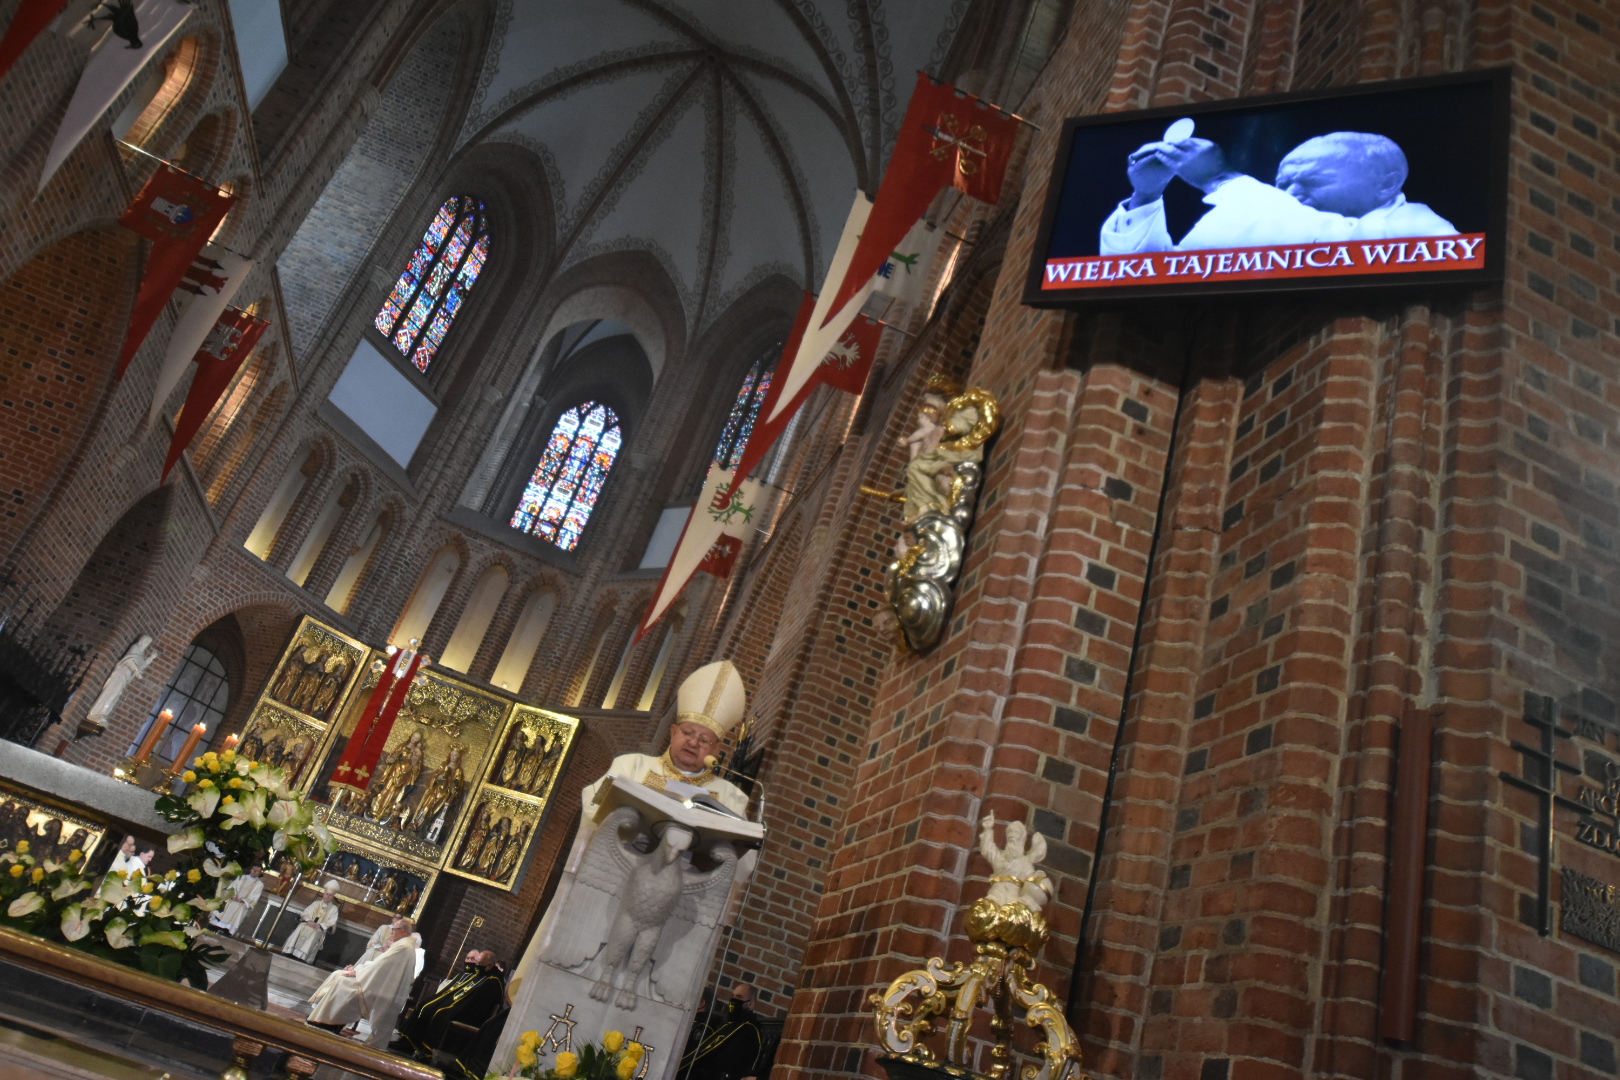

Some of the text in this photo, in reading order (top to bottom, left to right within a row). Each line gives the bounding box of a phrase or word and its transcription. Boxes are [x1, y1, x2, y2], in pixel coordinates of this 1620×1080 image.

[1046, 238, 1483, 283] WIELKA TAJEMNICA WIARY
